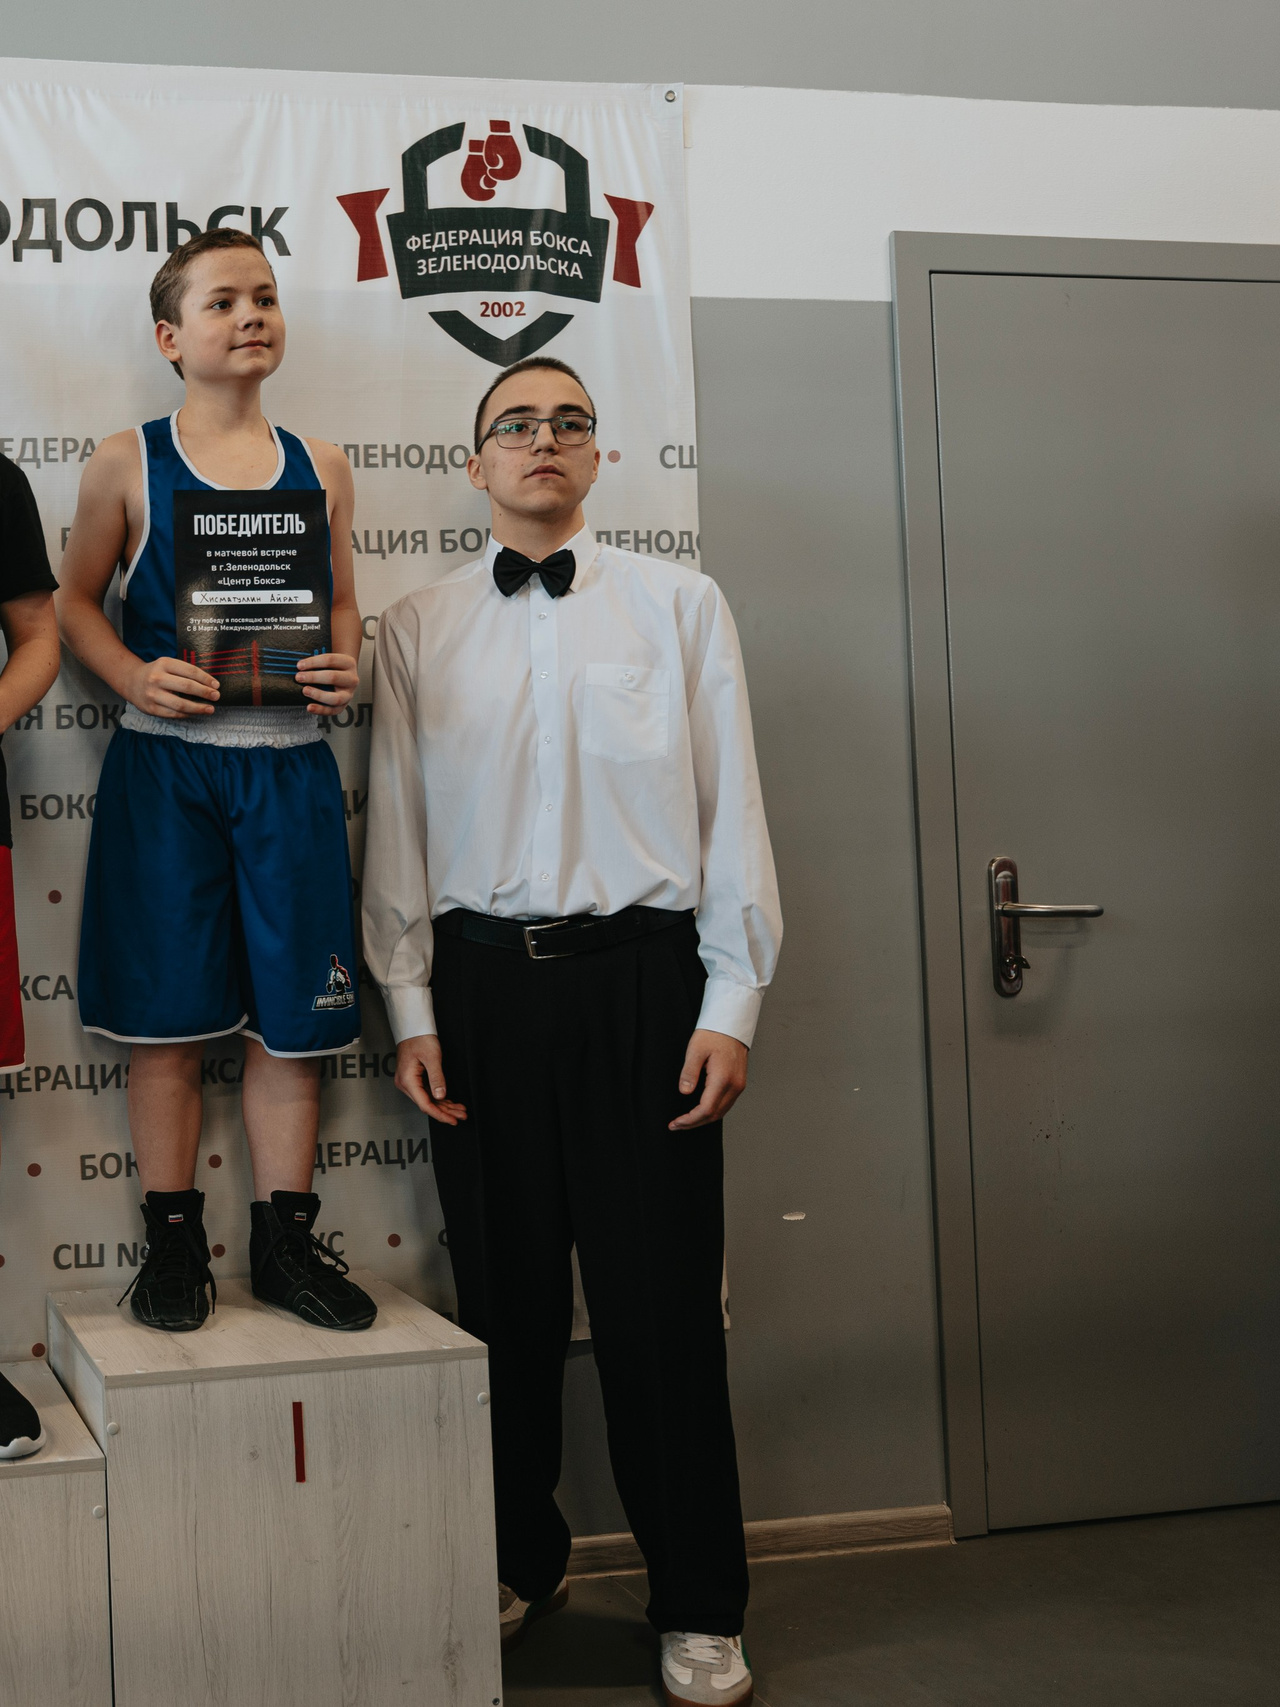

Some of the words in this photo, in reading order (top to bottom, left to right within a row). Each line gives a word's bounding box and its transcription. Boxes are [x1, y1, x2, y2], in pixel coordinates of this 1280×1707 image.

[406, 229, 523, 252] ФЕДЕРАЦИЯ
[529, 231, 592, 257] БОКСА
[416, 253, 583, 279] ЗЕЛЕНОДОЛЬСКА
[479, 301, 526, 317] 2002
[193, 513, 306, 537] ПОБЕДИТЕЛЬ
[214, 548, 258, 557] матчевой
[260, 549, 297, 558] встрече
[219, 563, 291, 572] г.Зеленодольск
[218, 577, 251, 586] «Центр
[253, 577, 285, 585] Бокса»
[56, 704, 119, 729] БОК
[20, 975, 75, 1001] КСА
[80, 1152, 140, 1180] БОК
[314, 1138, 433, 1174] ДЕРАЦИ
[53, 1243, 104, 1270] СШ
